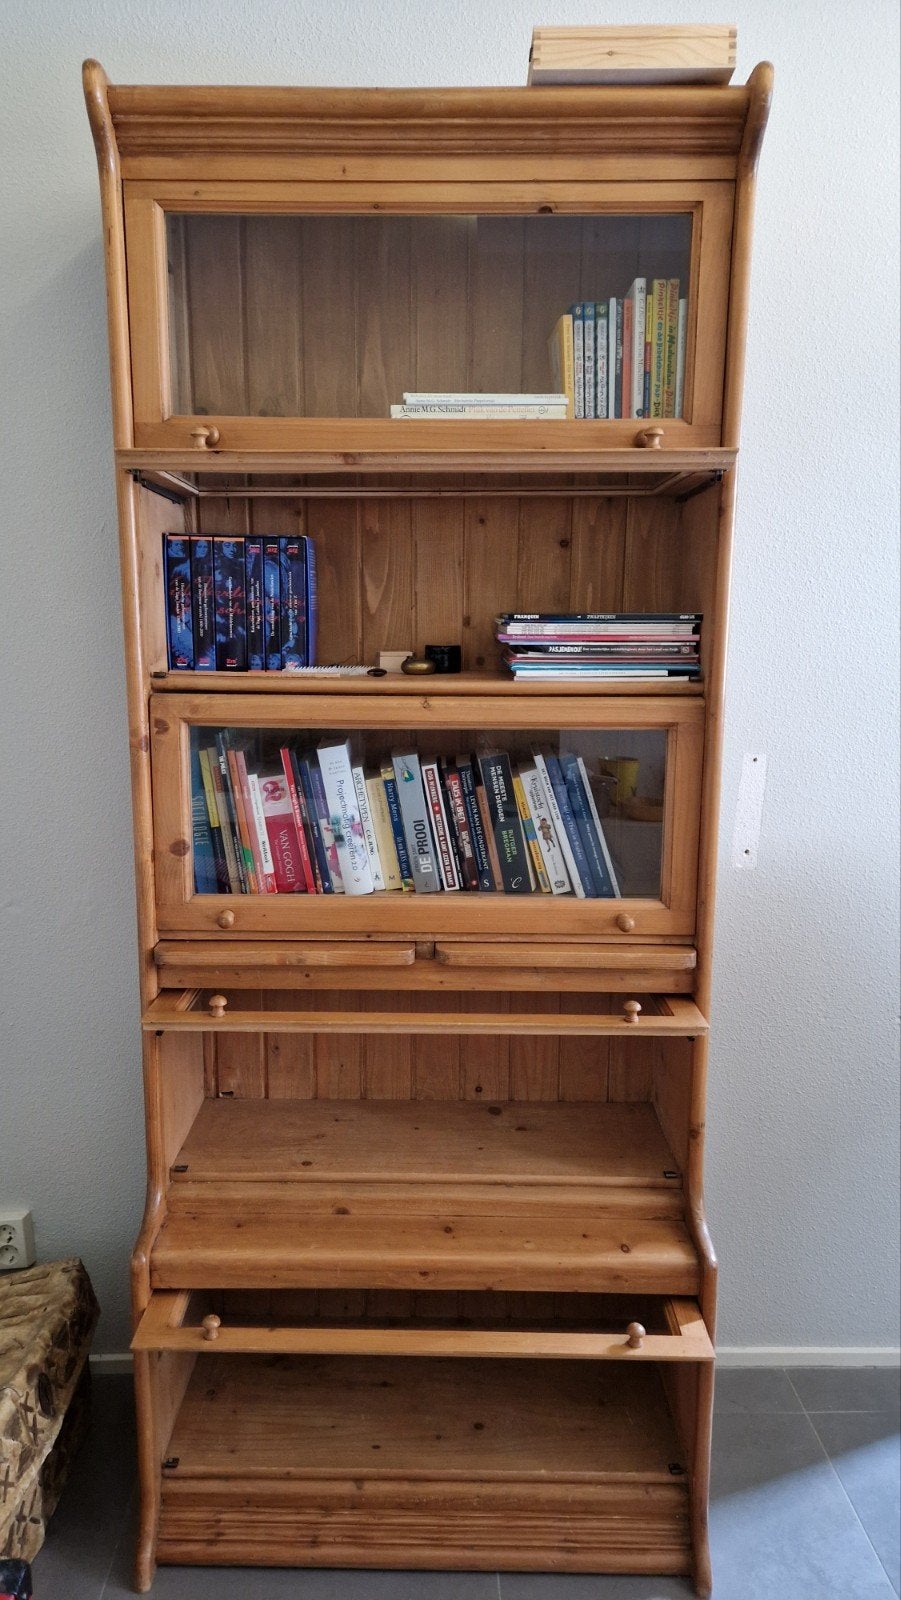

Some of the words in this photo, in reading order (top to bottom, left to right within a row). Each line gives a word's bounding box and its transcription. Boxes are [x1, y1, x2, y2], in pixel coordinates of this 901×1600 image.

[656, 282, 665, 320] Pinkeltje
[668, 283, 678, 322] Pinkeltje
[666, 335, 676, 385] Madurodam
[496, 766, 502, 774] DE
[354, 772, 370, 822] ARCHETYPEN
[387, 783, 398, 803] Harry
[452, 781, 460, 797] DUS
[455, 798, 462, 806] IK
[490, 766, 500, 793] MENSEN
[495, 795, 505, 822] DEUGEN
[498, 776, 507, 801] MEESTE
[336, 780, 349, 830] Projectmatig
[456, 807, 465, 823] BEN
[279, 829, 290, 849] VAN
[413, 820, 429, 855] PROOI
[502, 830, 512, 863] BREGMAN
[508, 830, 517, 855] RUTGER
[284, 852, 295, 882] GOGH
[419, 857, 432, 873] DE
